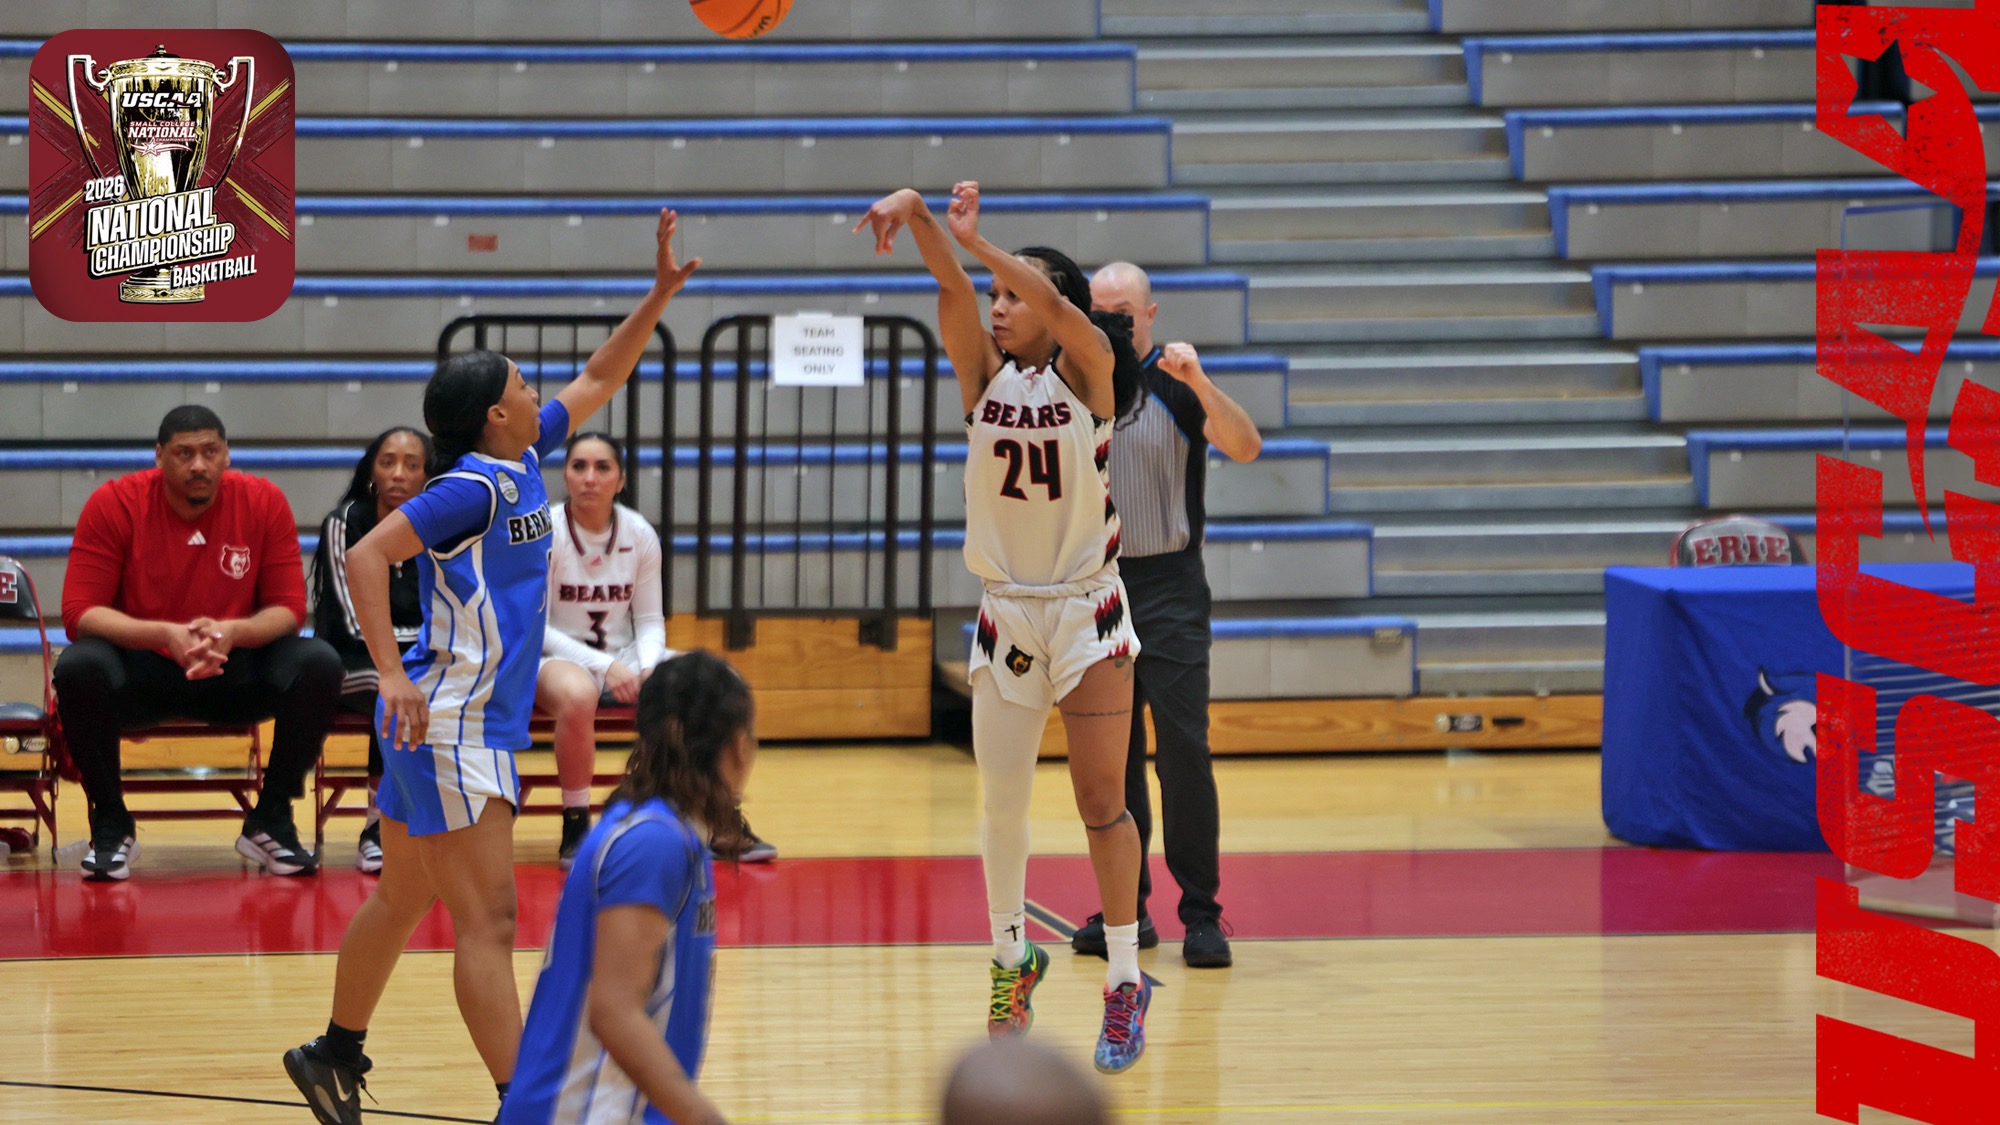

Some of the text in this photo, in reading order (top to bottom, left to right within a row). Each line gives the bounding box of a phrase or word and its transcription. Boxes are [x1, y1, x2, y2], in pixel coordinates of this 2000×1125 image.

[803, 327, 836, 338] TEAM
[793, 345, 845, 357] SEATING
[803, 363, 836, 375] ONLY
[980, 399, 1072, 430] BEARS
[993, 438, 1062, 502] 24
[1690, 533, 1792, 567] ERIE
[559, 583, 634, 603] BEARS
[584, 610, 610, 650] 3
